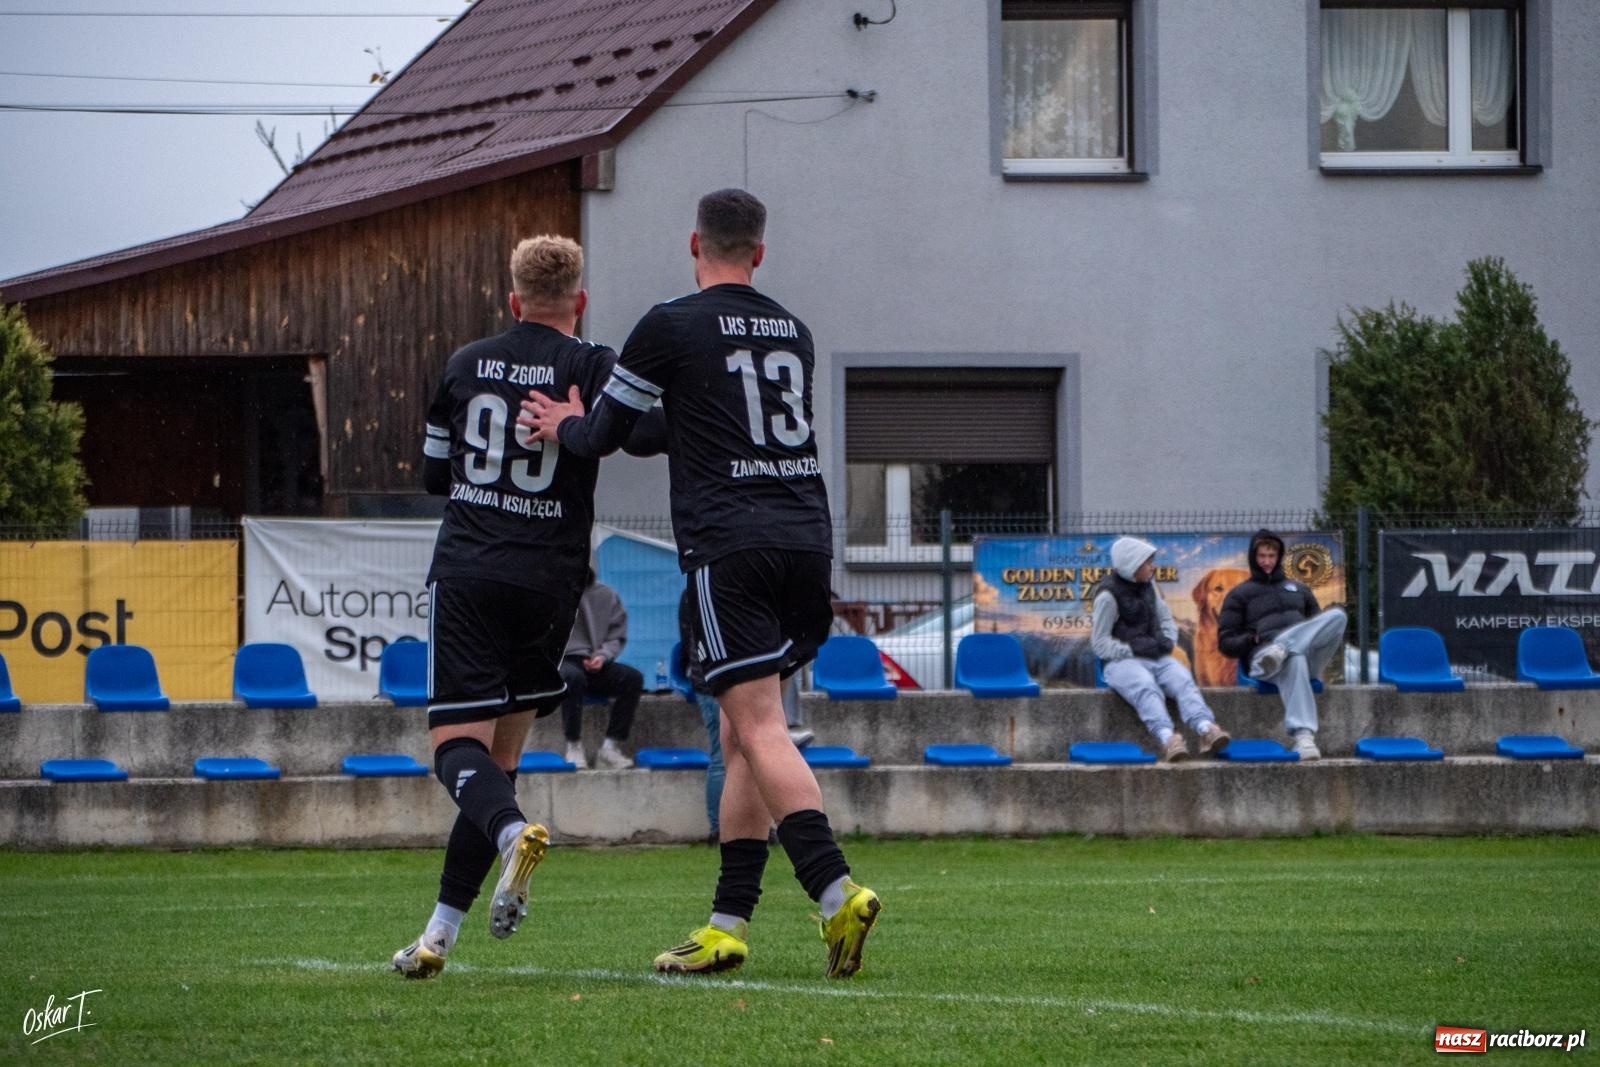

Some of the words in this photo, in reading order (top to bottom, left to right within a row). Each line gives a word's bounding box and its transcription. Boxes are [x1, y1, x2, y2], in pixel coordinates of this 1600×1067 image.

[717, 315, 746, 335] LKS
[750, 318, 798, 338] ZGODA
[477, 359, 505, 380] LKS
[508, 364, 554, 385] ZGODA
[726, 350, 811, 447] 13
[465, 394, 559, 493] 99
[450, 484, 499, 508] ZAWADA
[502, 494, 562, 519] KSIĄŻĘCA
[1003, 568, 1075, 583] GOLDEN
[1401, 552, 1600, 597] MAT
[1018, 586, 1075, 601] ZŁOTA
[0, 599, 133, 658] Post
[1456, 615, 1542, 629] KAMPERY
[324, 626, 420, 672] Sp
